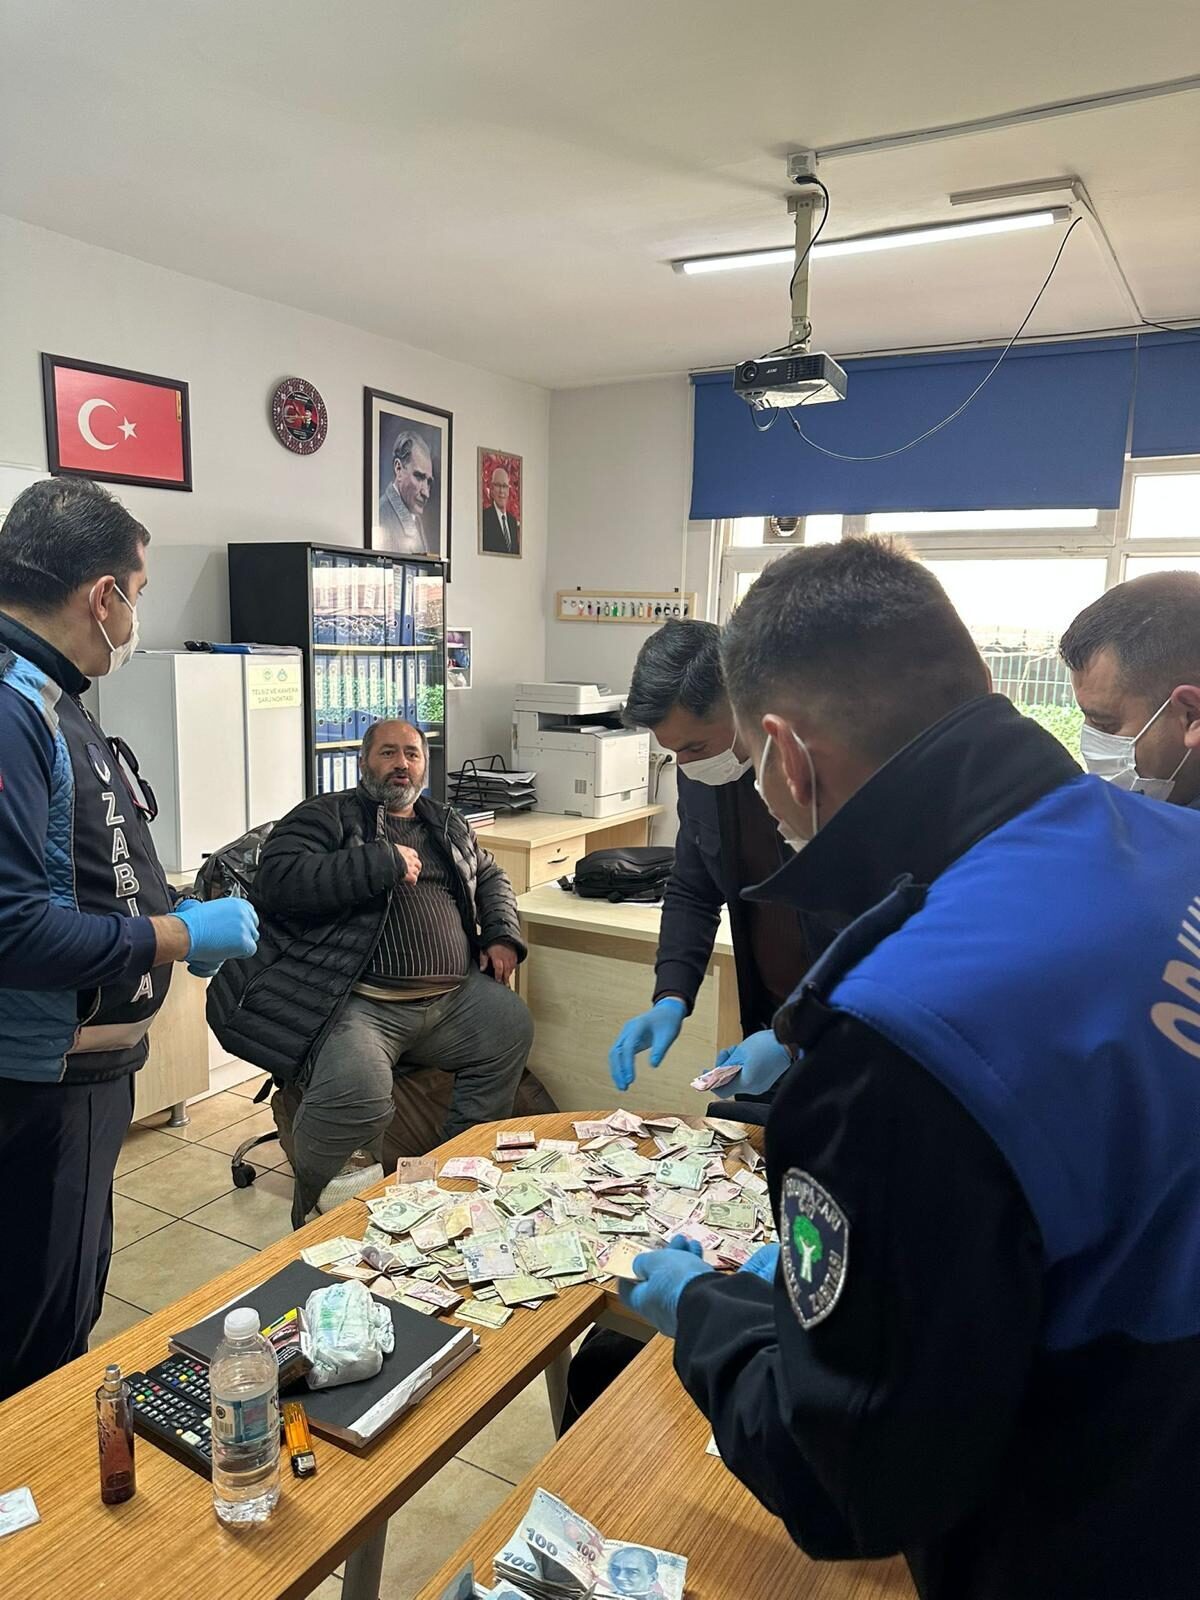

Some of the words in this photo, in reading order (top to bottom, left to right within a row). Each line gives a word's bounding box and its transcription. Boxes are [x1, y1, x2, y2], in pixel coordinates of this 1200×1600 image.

[660, 1161, 673, 1177] 20
[736, 1221, 750, 1229] 20
[526, 1526, 559, 1558] 100
[576, 1540, 596, 1562] 100
[503, 1551, 537, 1573] 100
